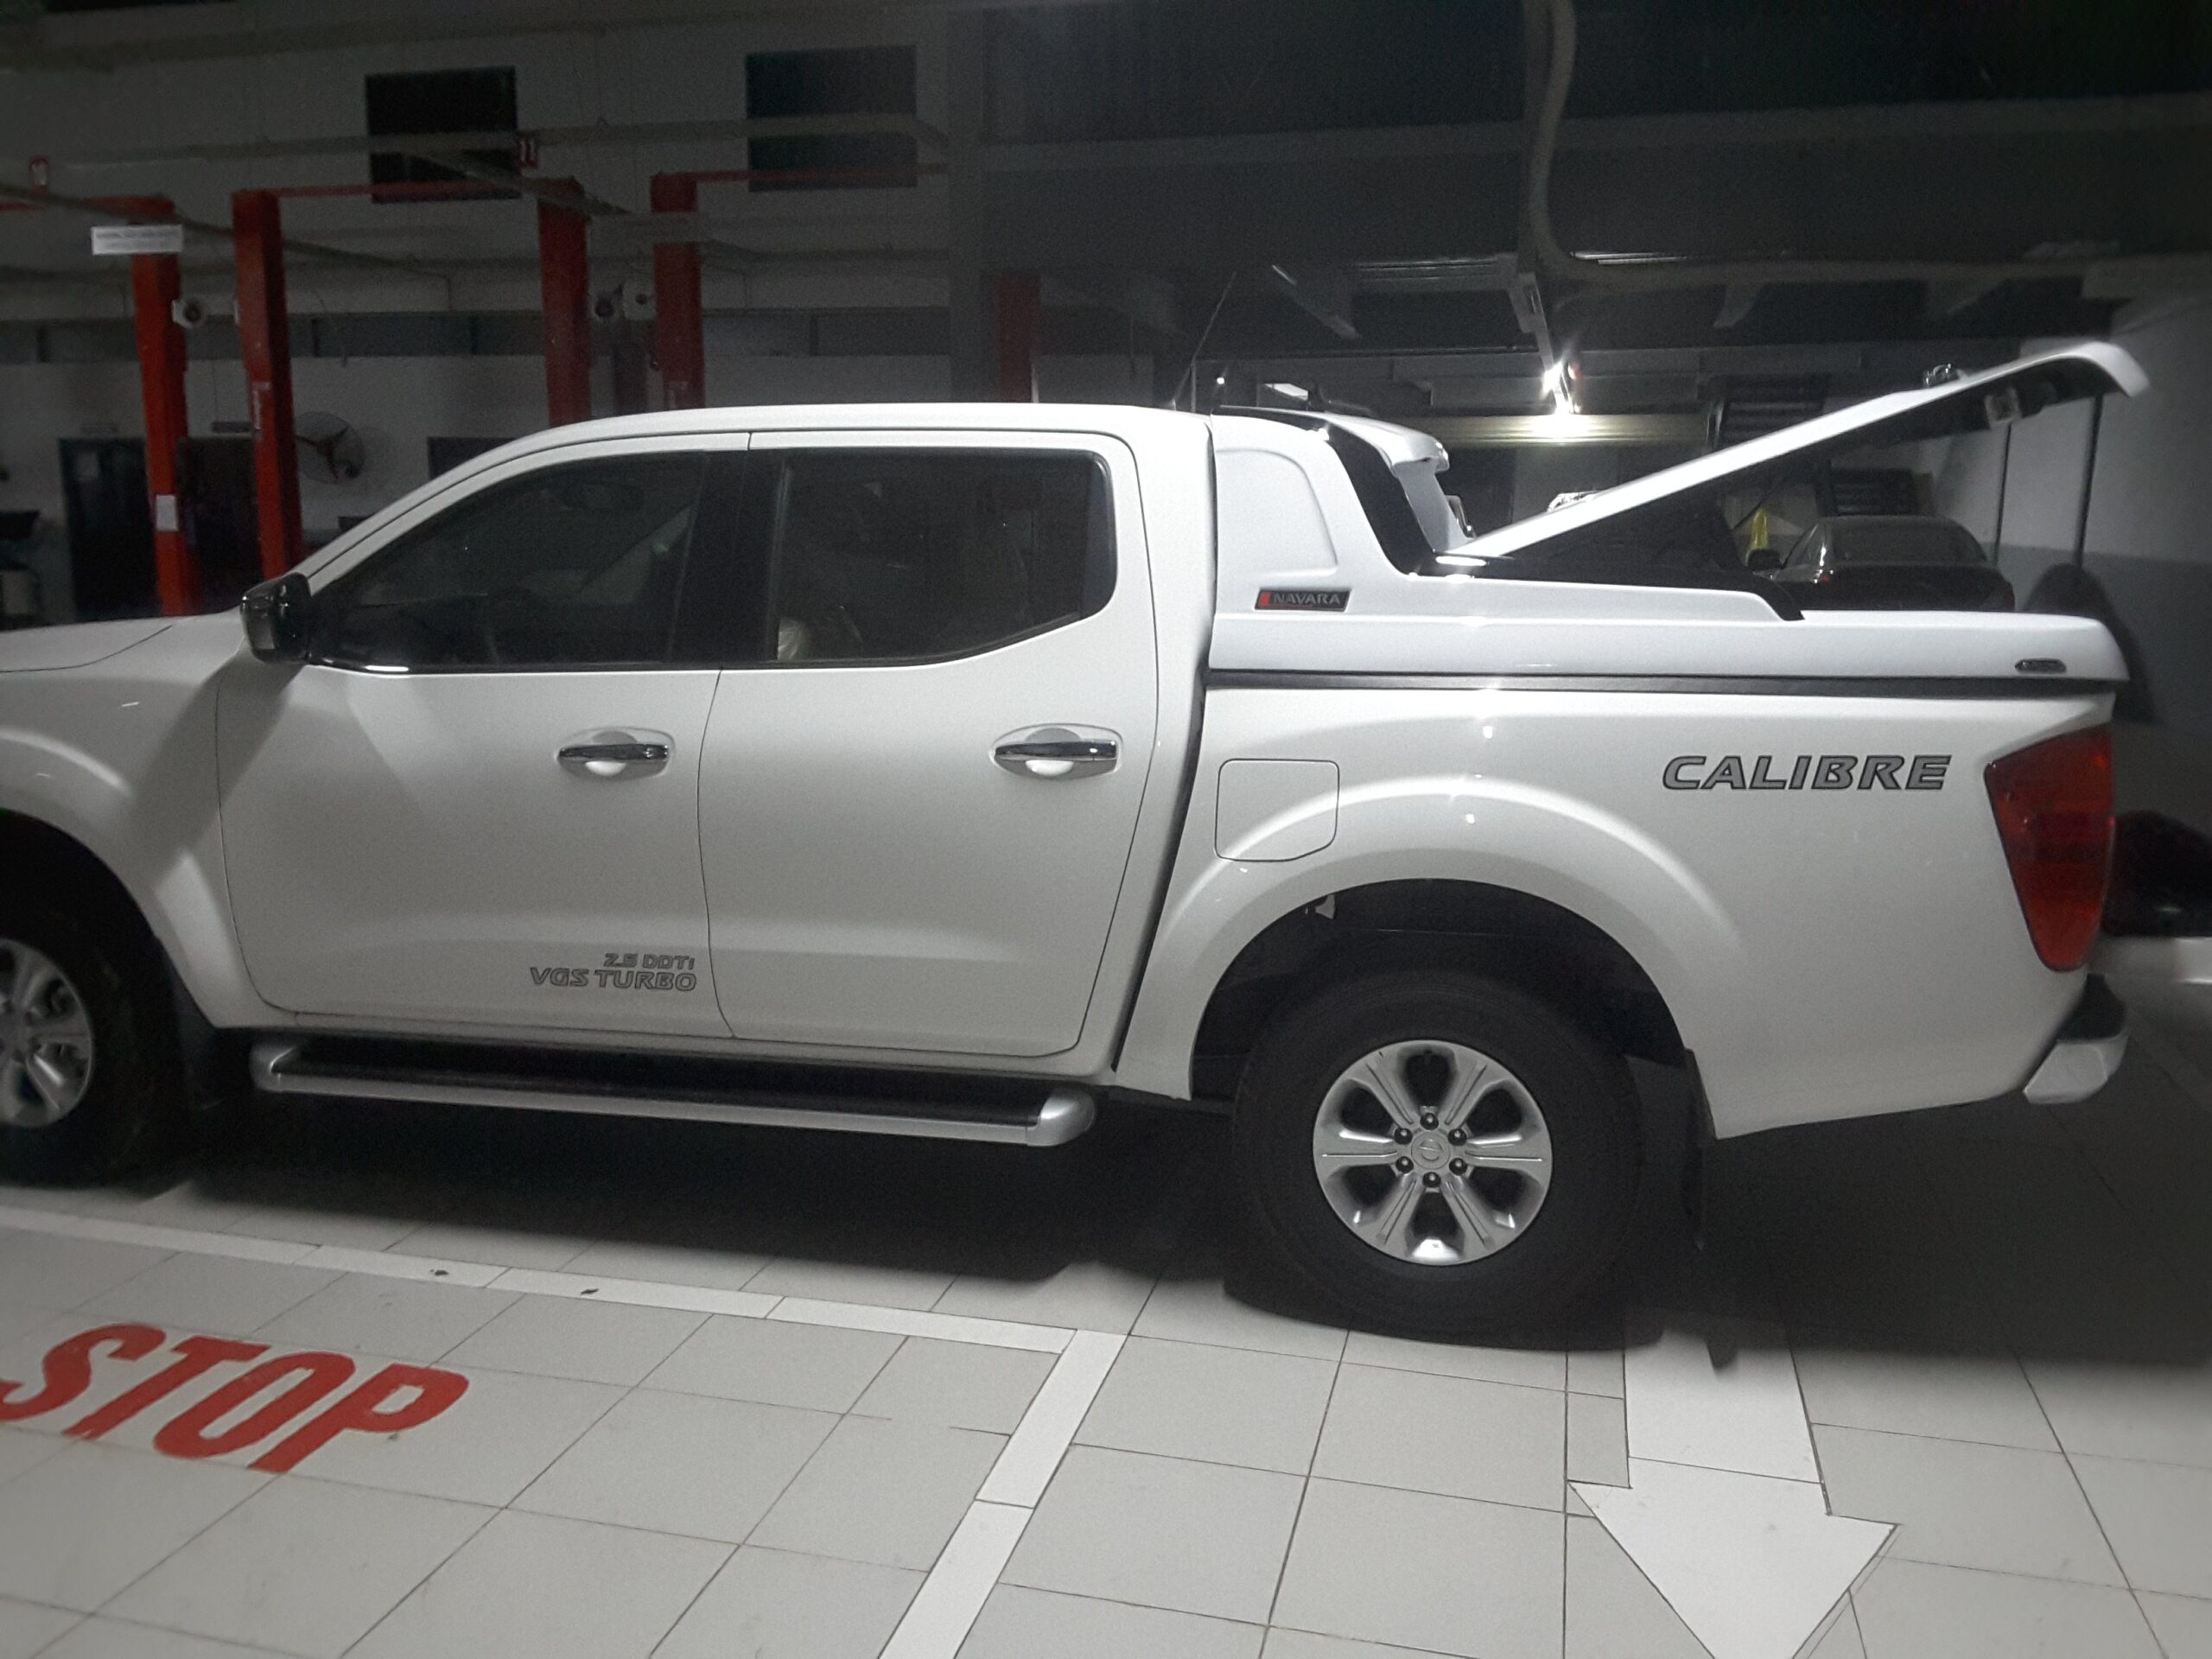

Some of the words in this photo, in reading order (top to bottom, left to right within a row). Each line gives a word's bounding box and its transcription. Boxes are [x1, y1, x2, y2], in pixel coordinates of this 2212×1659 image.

[1273, 594, 1339, 605] NAVARA
[1662, 754, 1952, 791] CALIBRE
[594, 969, 696, 992] TURBO
[0, 1322, 470, 1474] STOP
